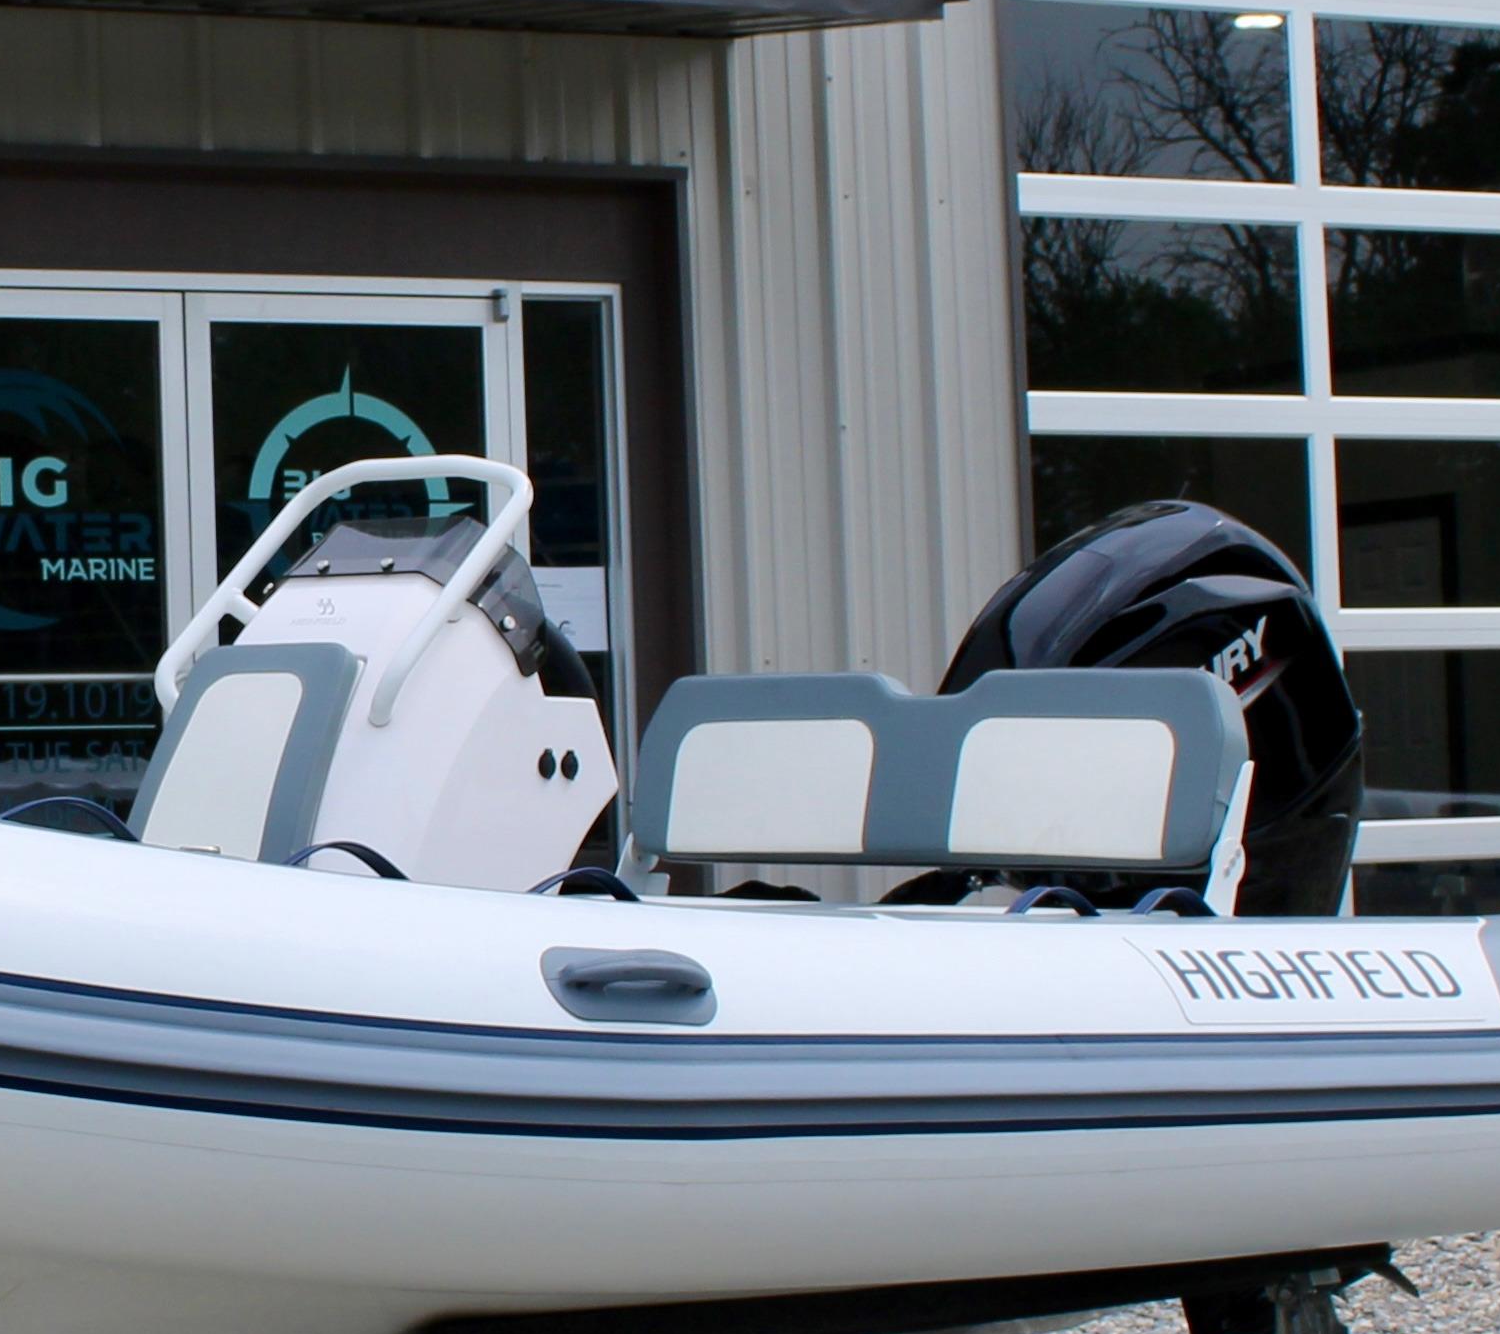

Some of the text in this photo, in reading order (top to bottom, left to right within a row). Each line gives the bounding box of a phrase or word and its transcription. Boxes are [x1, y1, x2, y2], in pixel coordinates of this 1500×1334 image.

[40, 557, 156, 583] MARINE
[6, 741, 71, 774] TUE
[85, 739, 146, 773] SAT
[1155, 950, 1463, 1000] HIGHFIELD
